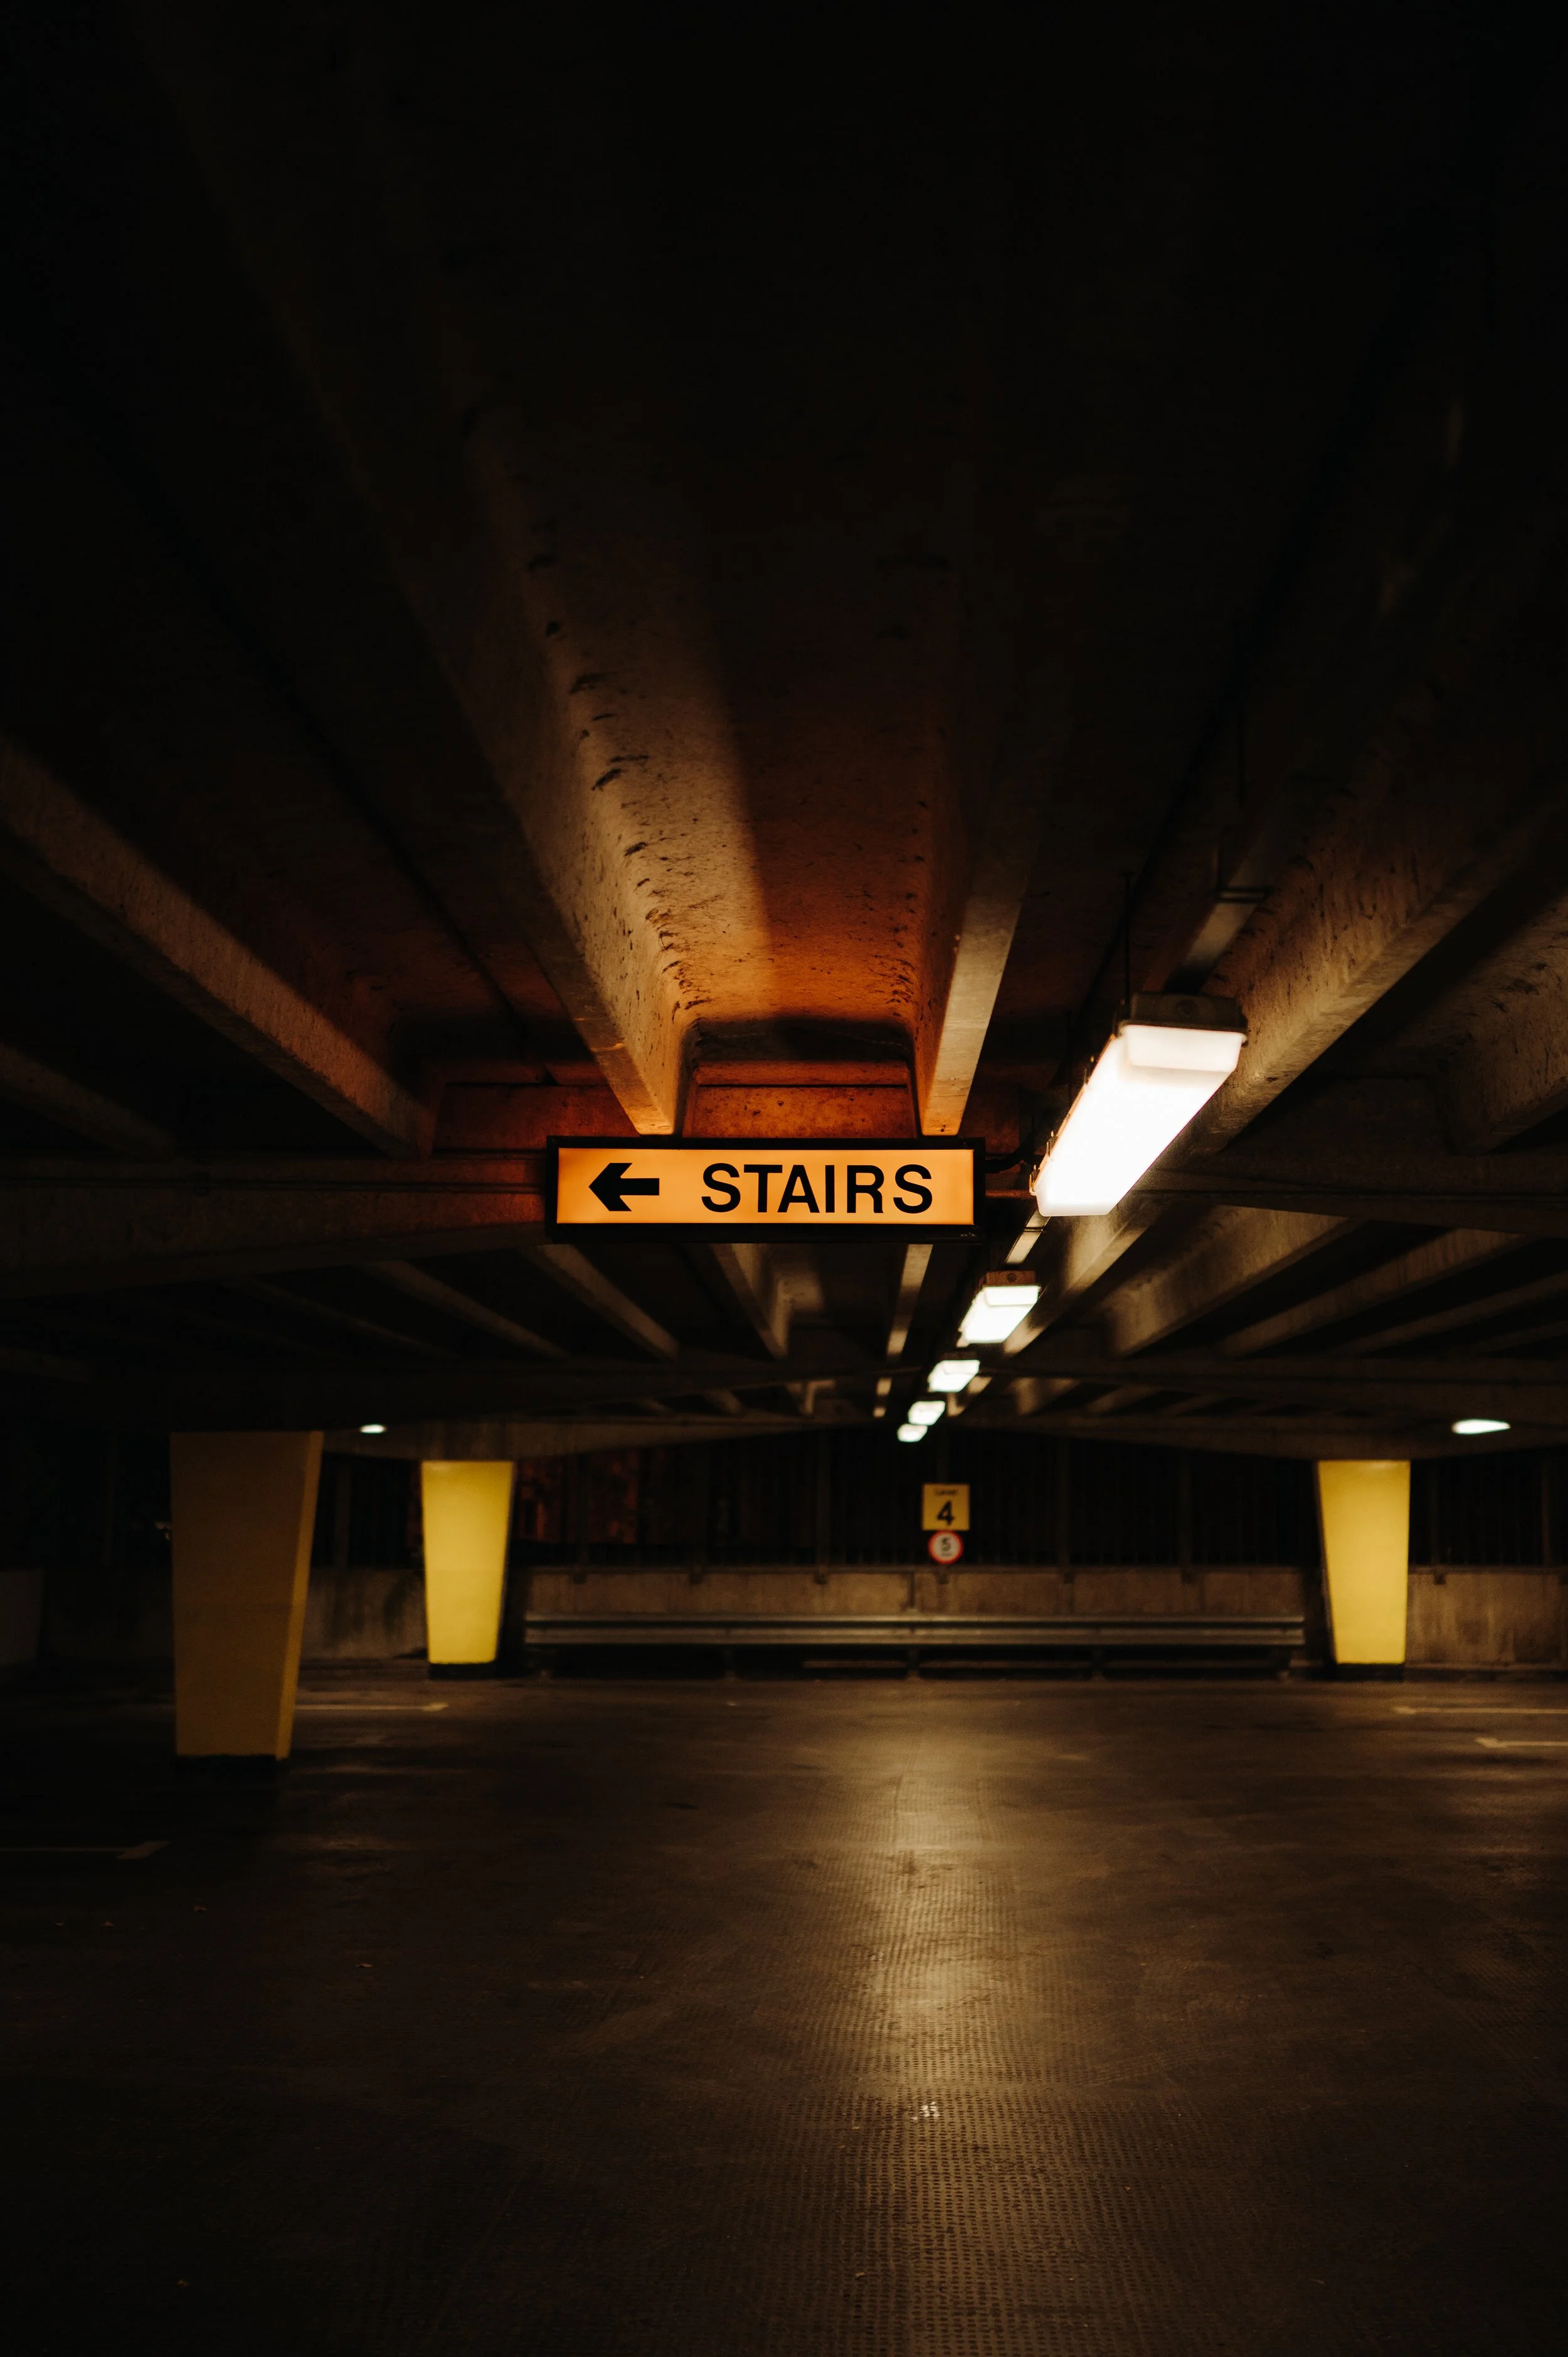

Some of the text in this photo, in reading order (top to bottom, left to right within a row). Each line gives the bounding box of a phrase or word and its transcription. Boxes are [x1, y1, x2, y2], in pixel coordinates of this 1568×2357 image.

[701, 1163, 933, 1215] STAIRS
[937, 1500, 955, 1526] 4
[941, 1537, 952, 1552] 5
